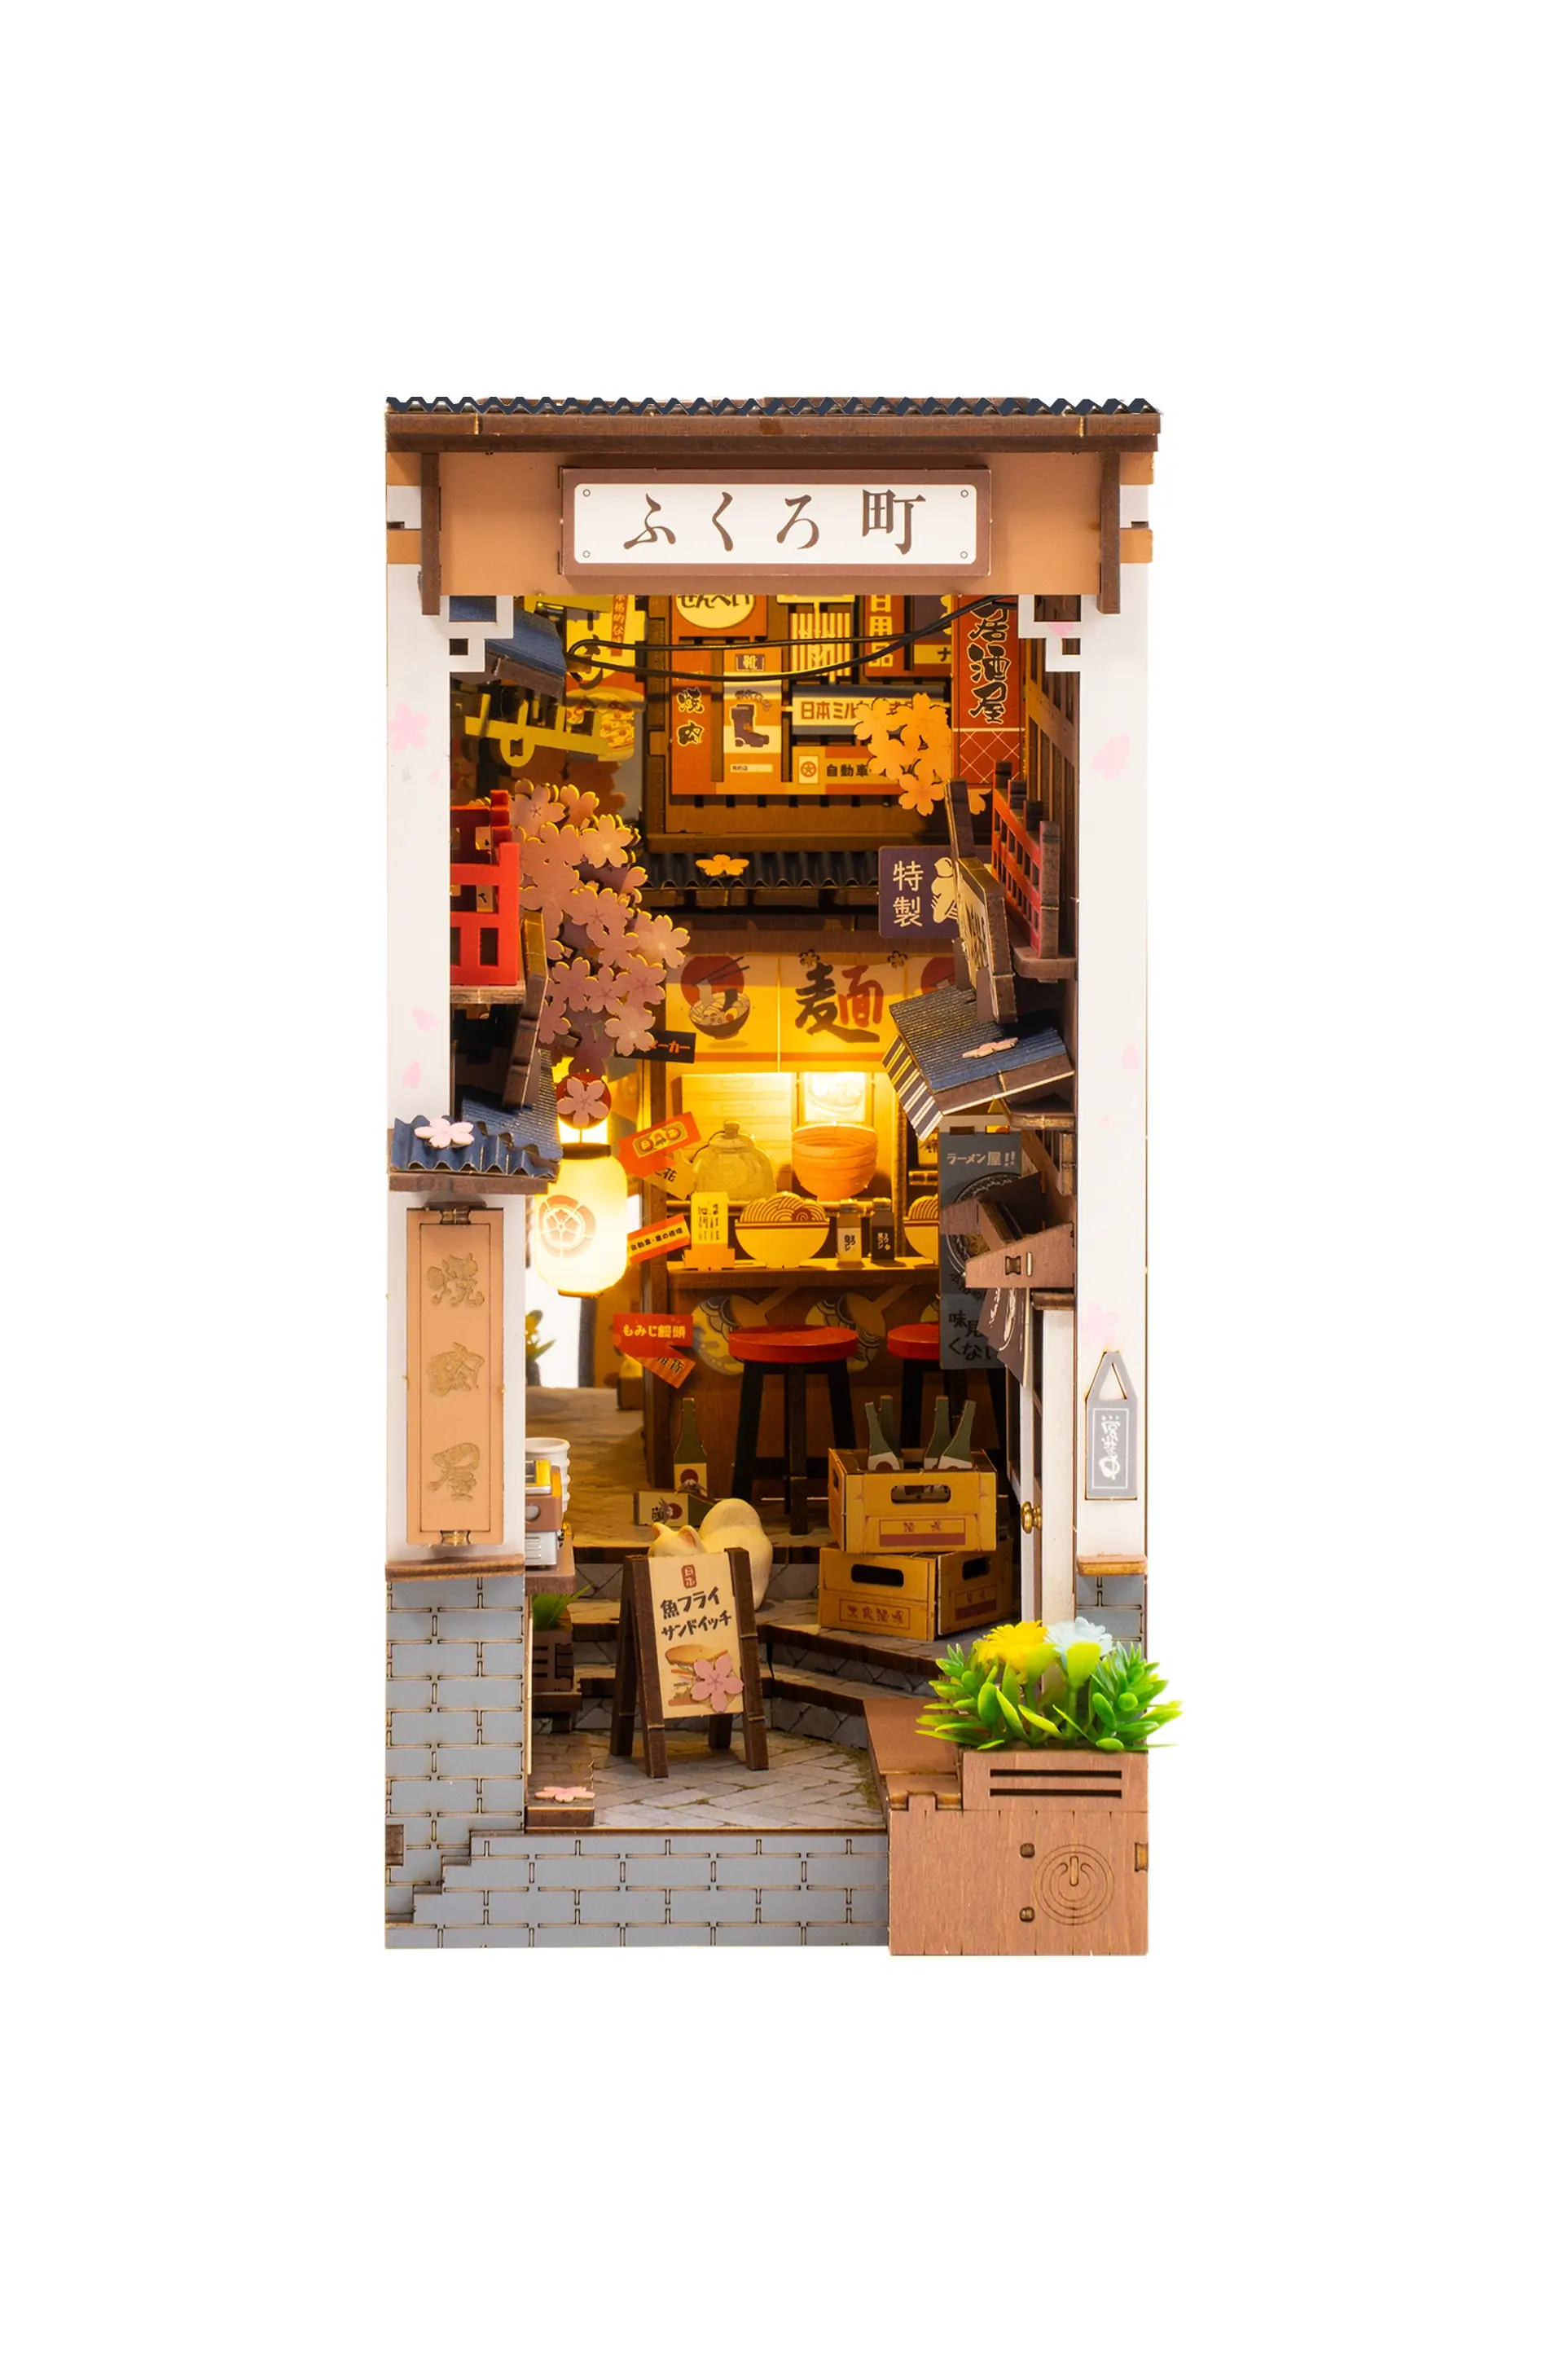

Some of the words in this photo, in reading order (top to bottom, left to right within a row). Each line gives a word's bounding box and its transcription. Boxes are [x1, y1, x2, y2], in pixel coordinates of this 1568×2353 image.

[623, 489, 926, 555] ふくろ町
[676, 687, 705, 747] 焼肉
[893, 860, 925, 928] 特製
[794, 961, 885, 1043] 麺
[622, 1324, 686, 1339] もみじ饅頭
[427, 1252, 485, 1502] 焼肉屋
[660, 1586, 720, 1620] 魚フライ
[661, 1610, 732, 1642] サンドイッチ
